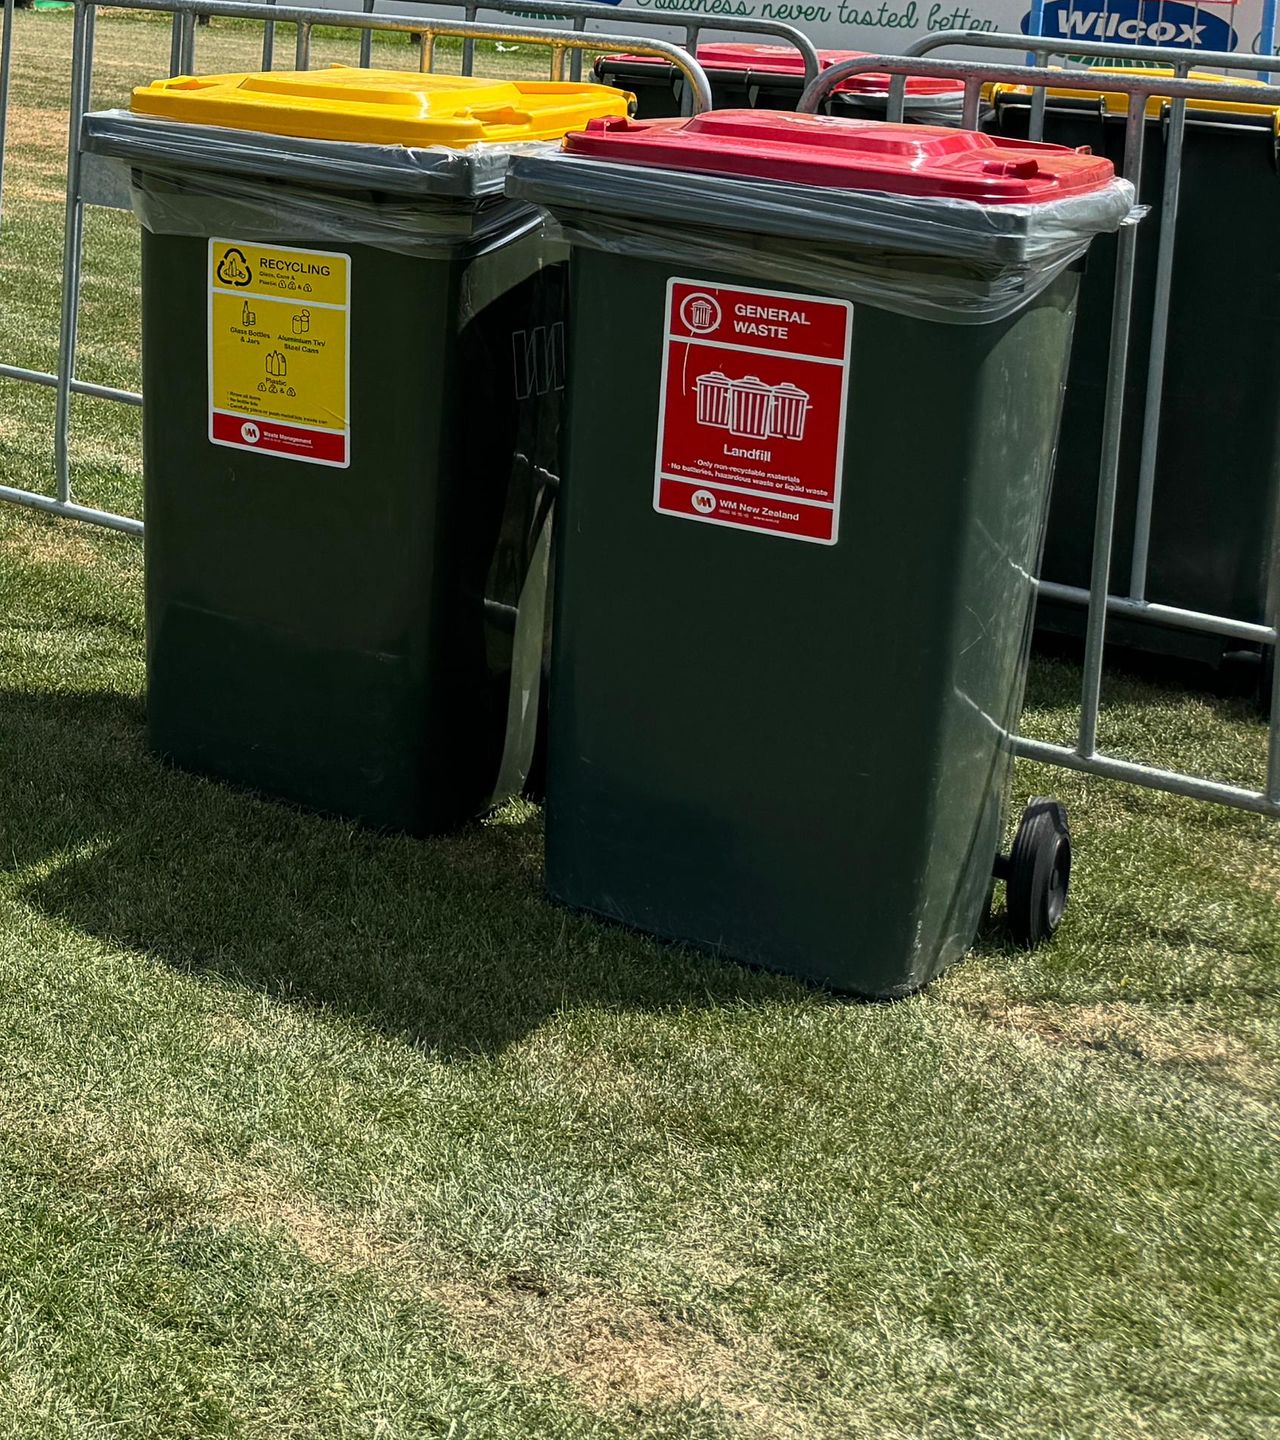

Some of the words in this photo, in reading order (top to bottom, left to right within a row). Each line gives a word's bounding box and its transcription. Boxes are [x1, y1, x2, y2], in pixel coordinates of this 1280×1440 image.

[761, 3, 831, 22] never
[837, 0, 919, 28] tasted
[927, 3, 999, 32] better
[1057, 9, 1207, 44] Wilcox
[260, 257, 331, 276] RECYCLING
[734, 303, 811, 325] GENERAL
[230, 326, 248, 336] Glass
[248, 328, 271, 339] Bottles
[277, 335, 312, 344] Aluminium
[733, 320, 789, 340] WASTE
[245, 337, 260, 345] Jars
[284, 343, 301, 351] Steel
[301, 346, 319, 355] Cans
[265, 377, 287, 387] Plastic
[263, 431, 279, 439] Waste
[279, 433, 312, 445] Management
[723, 443, 771, 462] Landfill
[671, 462, 681, 470] No
[682, 464, 714, 477] batteries,
[715, 470, 751, 484] hazardous
[752, 478, 774, 488] waste
[775, 481, 783, 489] or
[784, 482, 804, 493] liquid
[805, 487, 828, 497] waste
[697, 459, 713, 469] Only
[714, 462, 766, 478] non-recyclable
[766, 472, 800, 483] materials
[719, 499, 737, 509] WM
[739, 503, 760, 514] New
[762, 507, 800, 521] Zealand
